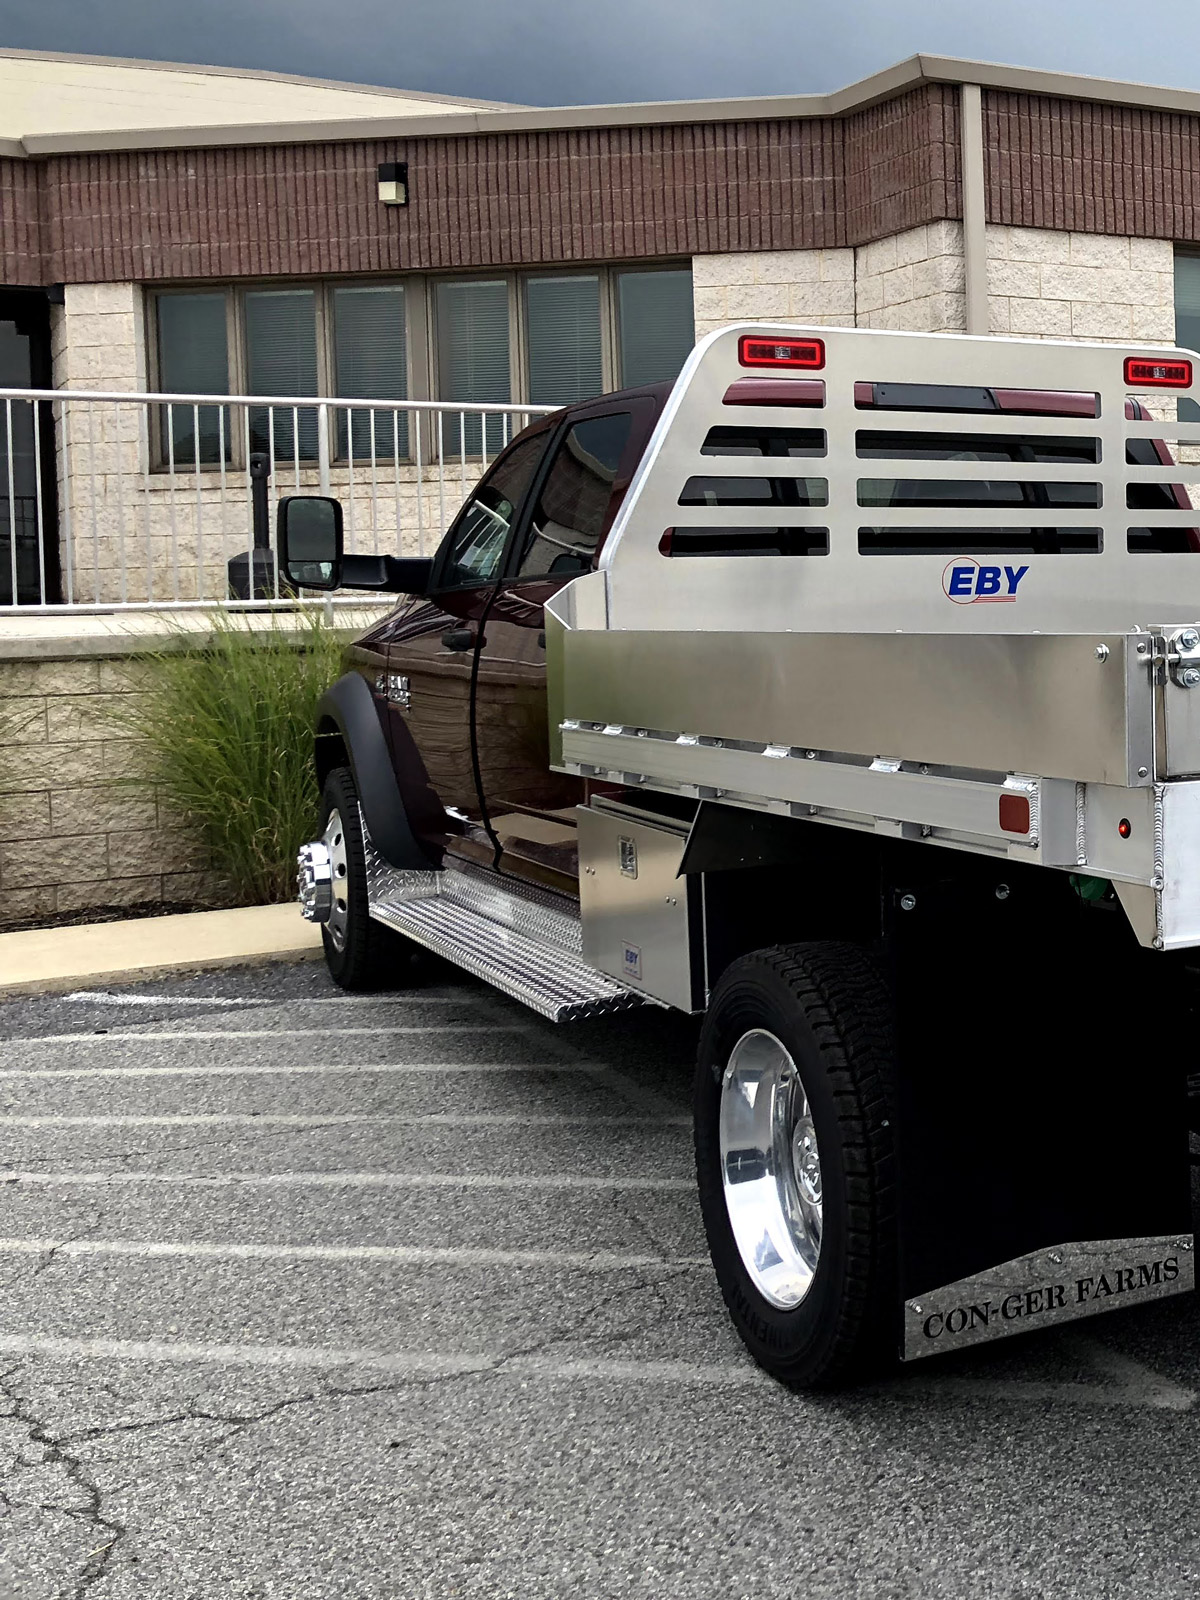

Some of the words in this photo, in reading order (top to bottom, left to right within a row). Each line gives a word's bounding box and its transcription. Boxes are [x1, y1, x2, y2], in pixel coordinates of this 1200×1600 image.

[948, 565, 1030, 596] EBY
[922, 1284, 1068, 1339] CON-GER
[1074, 1256, 1180, 1304] FARMS
